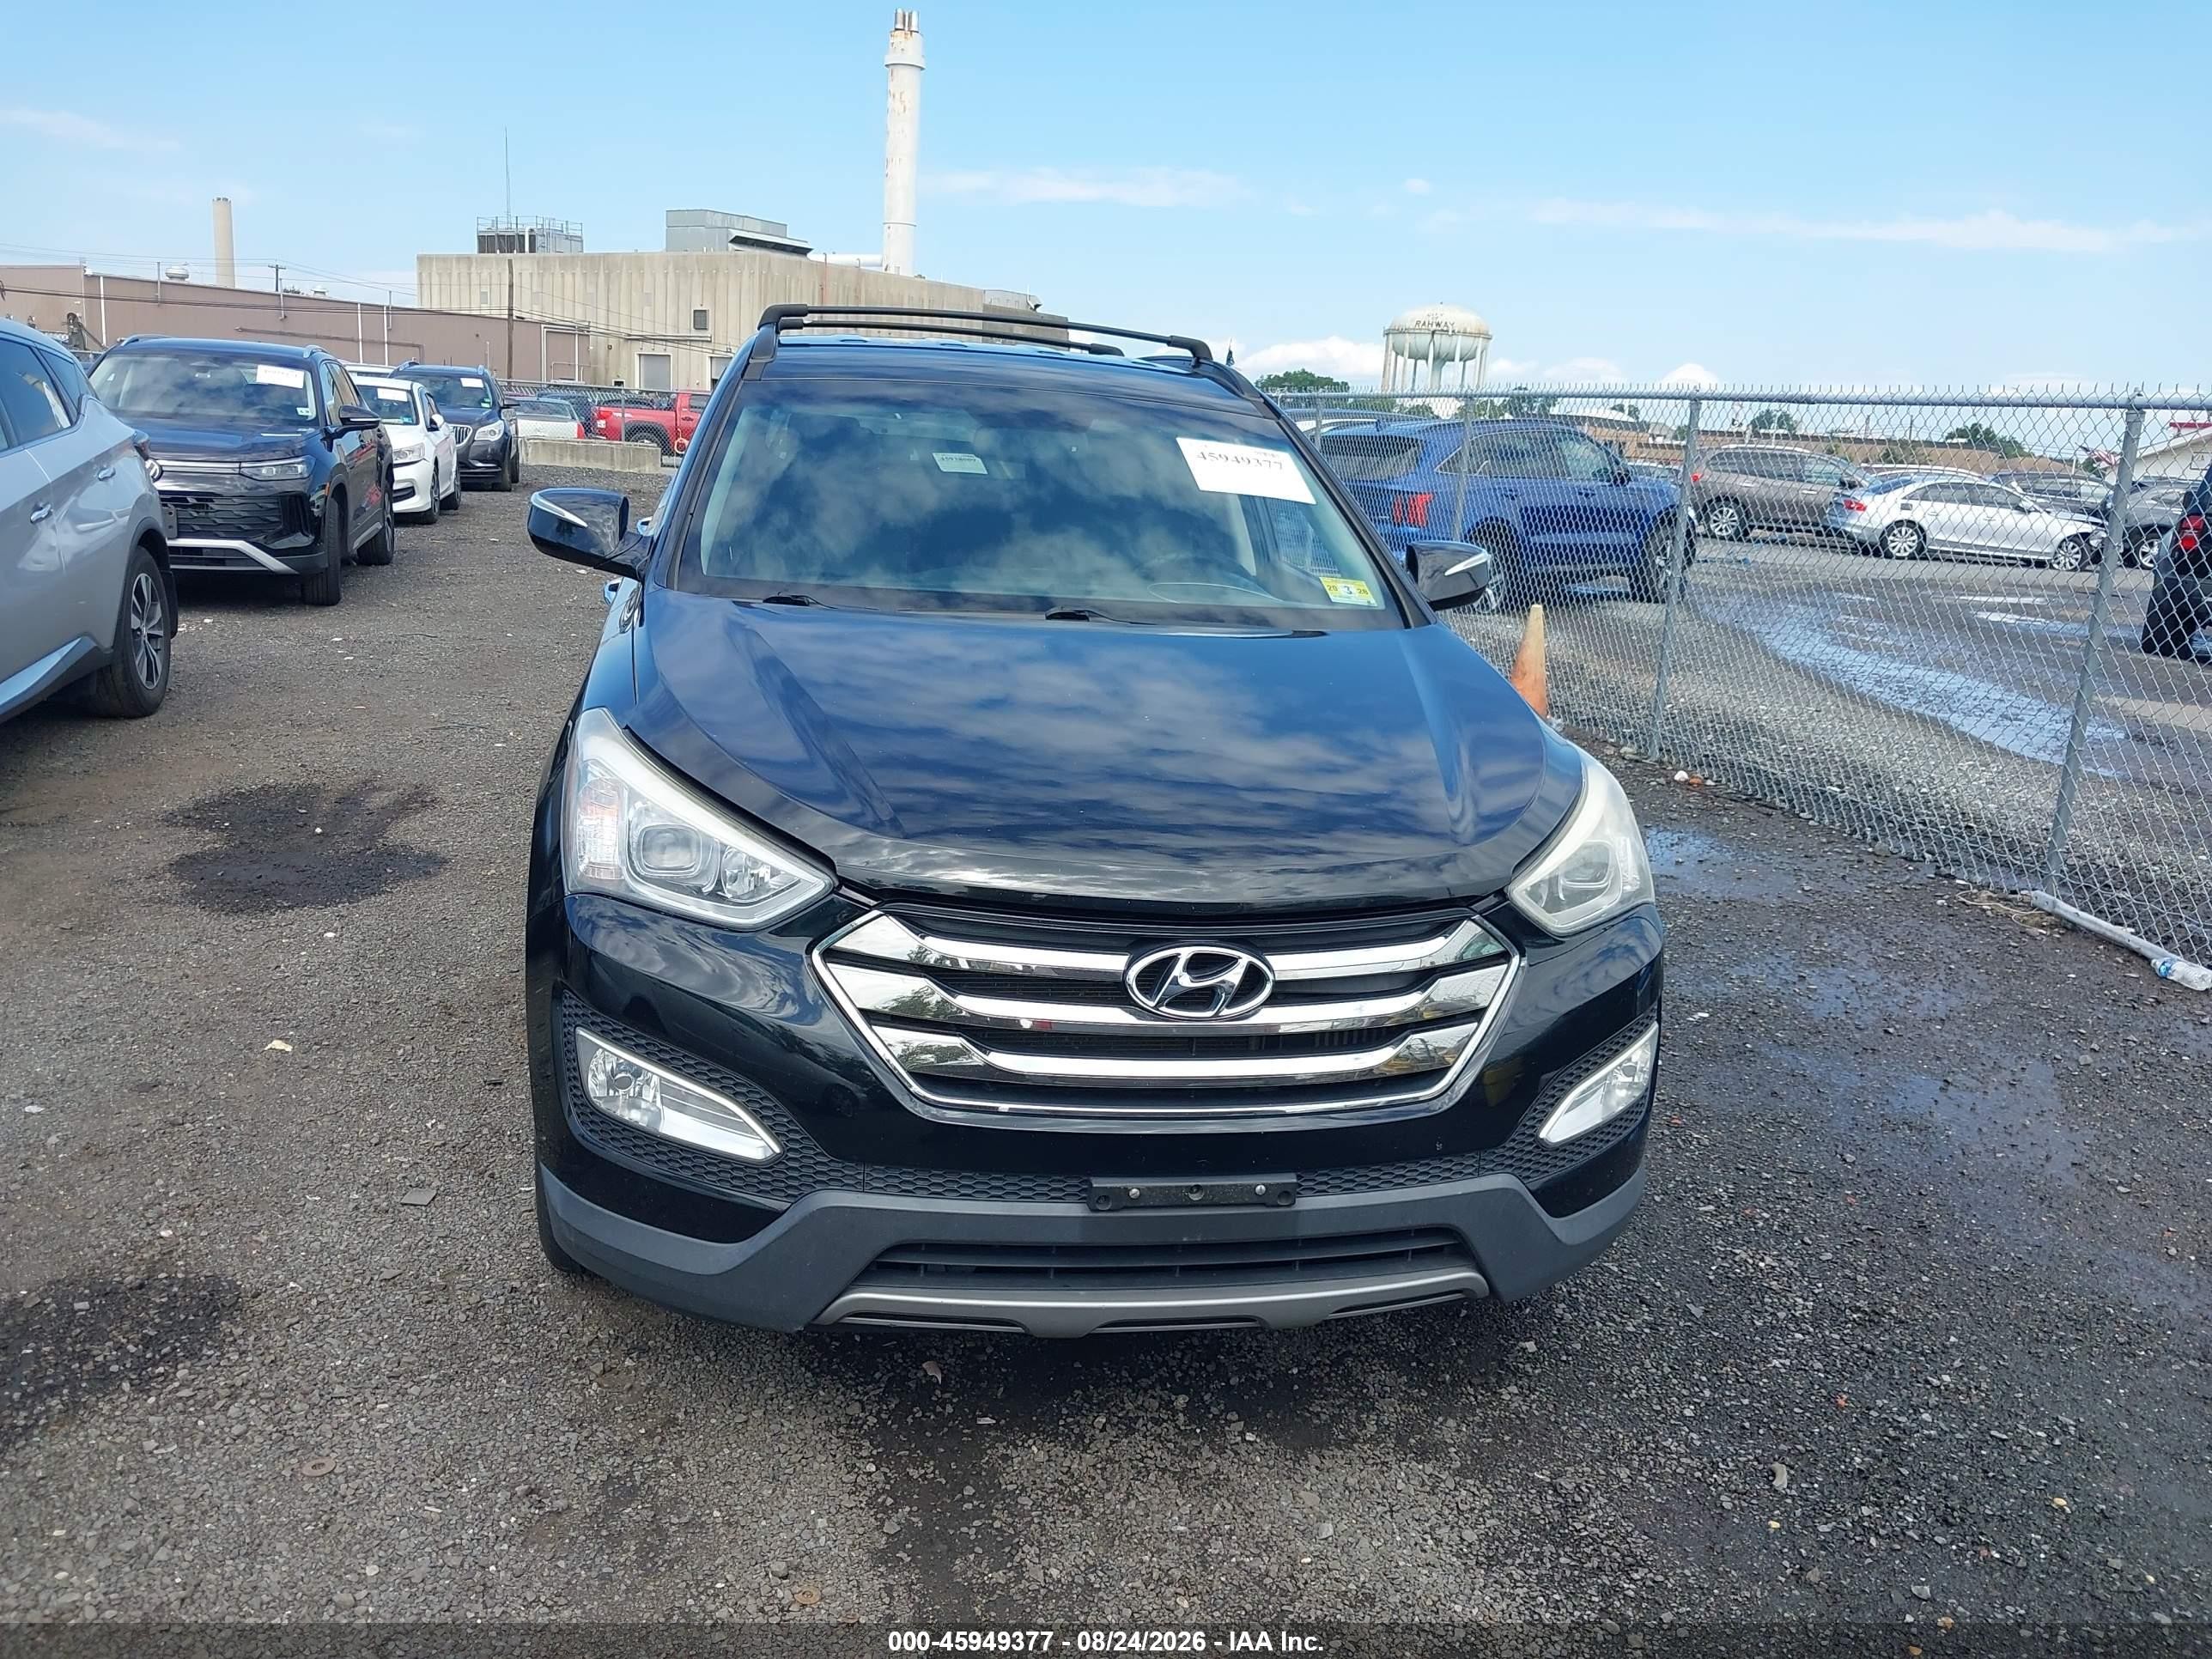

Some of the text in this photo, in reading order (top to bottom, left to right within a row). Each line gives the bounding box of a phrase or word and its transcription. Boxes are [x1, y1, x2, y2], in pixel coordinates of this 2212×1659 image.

[1414, 319, 1455, 329] RAHWAY
[1196, 451, 1283, 470] 45949377
[1343, 585, 1352, 595] 3
